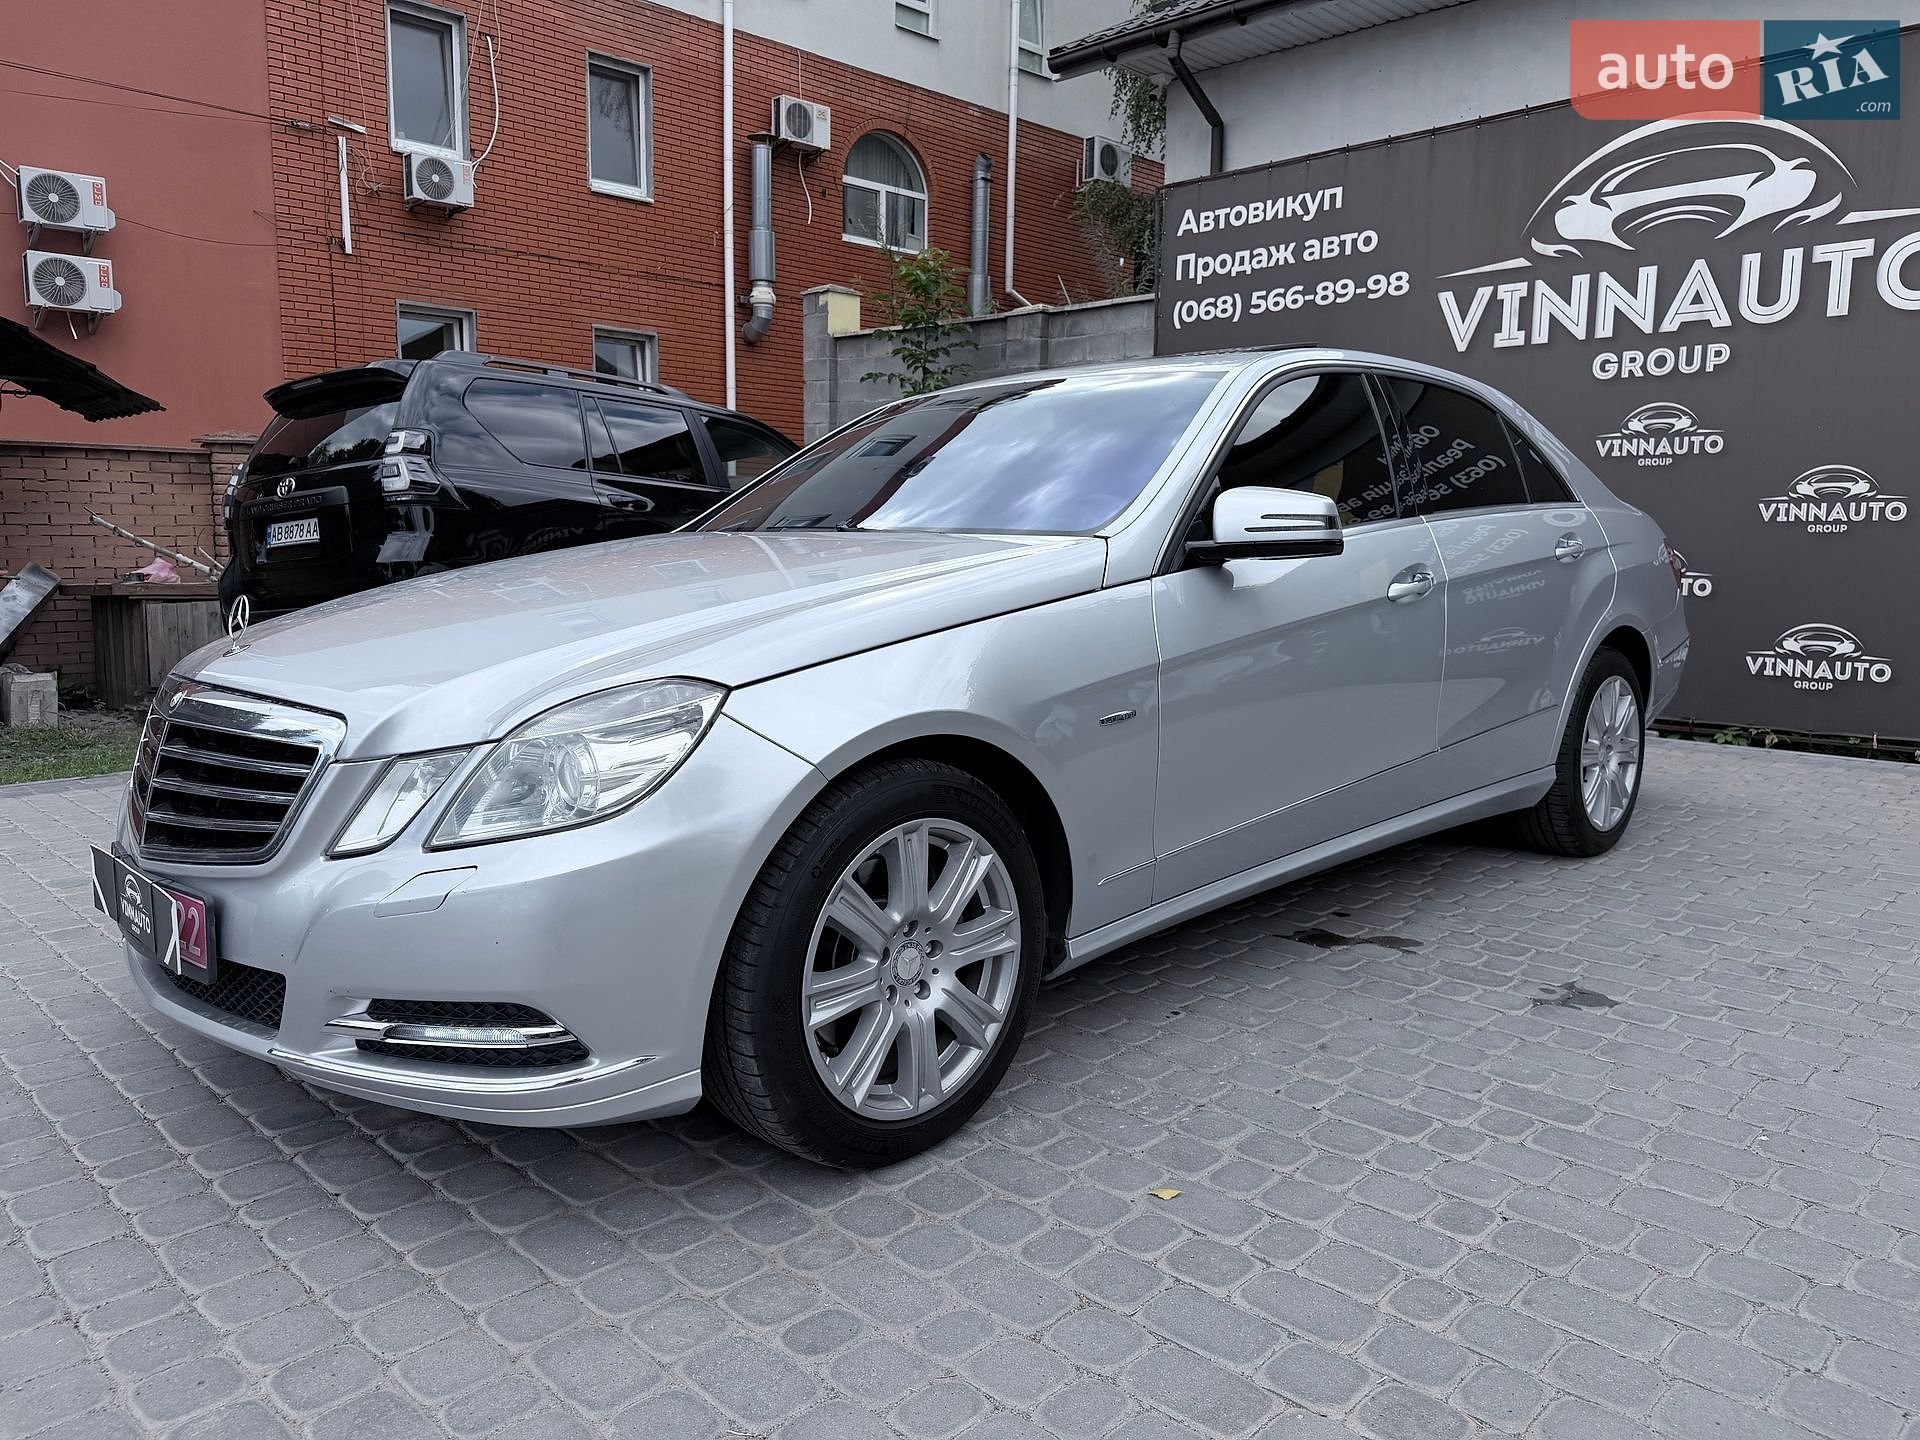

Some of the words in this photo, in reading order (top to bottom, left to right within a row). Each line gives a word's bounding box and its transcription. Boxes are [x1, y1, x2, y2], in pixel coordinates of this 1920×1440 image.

[1176, 186, 1344, 236] Автовикуп
[1175, 242, 1297, 285] Продаж
[1302, 230, 1379, 262] авто
[1173, 293, 1242, 330] (068)
[1249, 271, 1411, 315] 566-89-98
[1592, 342, 1731, 381] GROUP
[1595, 434, 1725, 457] VINNAUTO
[1637, 457, 1673, 467] GROUP
[1758, 501, 1908, 522] VINNAUTO
[272, 526, 283, 543] AB
[284, 523, 304, 541] 8878
[306, 521, 319, 538] AA
[1807, 523, 1848, 533] GROUP
[1745, 655, 1892, 683] VINNAUTO
[1793, 680, 1833, 691] GROUP
